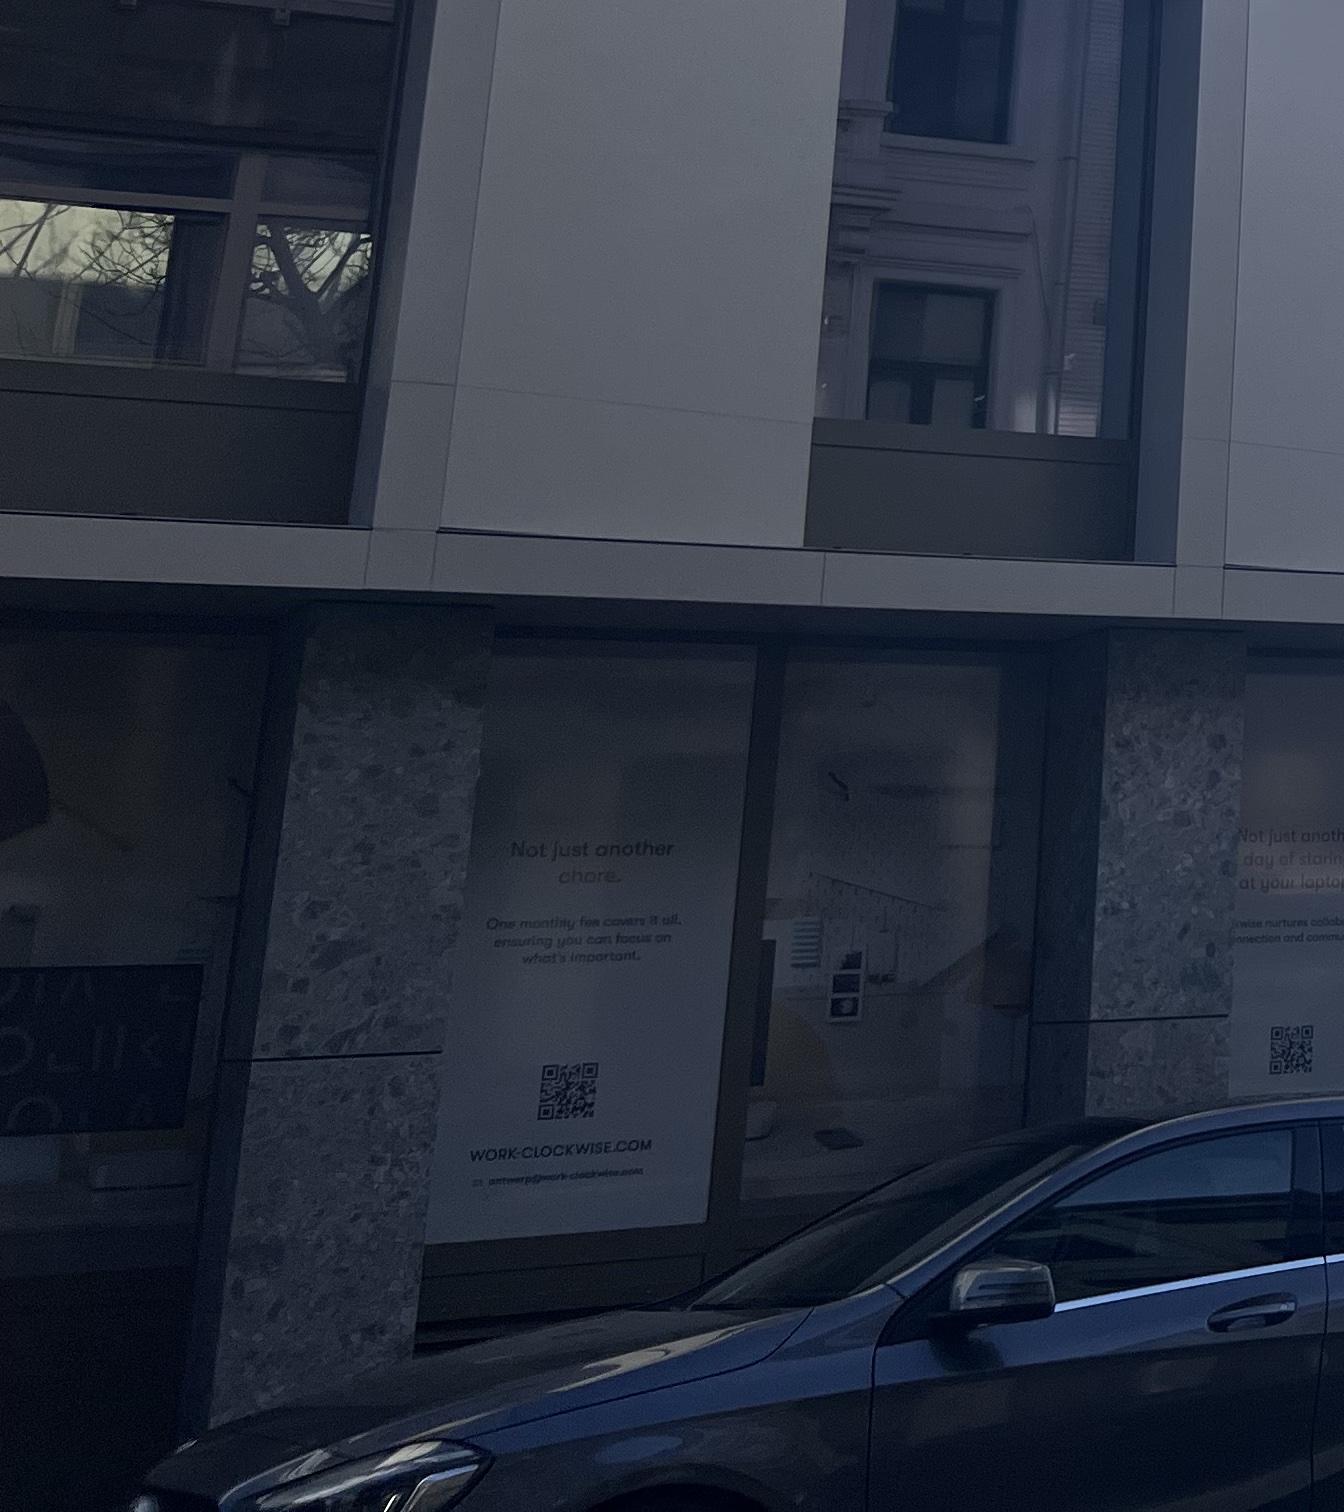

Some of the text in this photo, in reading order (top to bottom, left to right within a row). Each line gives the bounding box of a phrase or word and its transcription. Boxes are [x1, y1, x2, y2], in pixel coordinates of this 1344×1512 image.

[1238, 828, 1264, 843] Not
[1268, 828, 1297, 847] just
[510, 838, 675, 862] Not just another
[1243, 851, 1275, 870] day
[1279, 850, 1295, 866] of
[558, 868, 622, 885] chore.
[1238, 877, 1256, 890] at
[1260, 878, 1295, 894] your
[486, 916, 516, 930] One
[520, 915, 576, 931] monthly
[579, 915, 600, 927] fee
[603, 917, 645, 927] covers
[649, 915, 658, 926] it
[1235, 919, 1262, 928] wise
[1265, 918, 1308, 928] nurtures
[494, 933, 672, 949] ensuring you can focus on
[1284, 932, 1304, 943] and
[522, 950, 641, 965] what's important.
[470, 1139, 653, 1162] WORK-CLOCKWISE.COM
